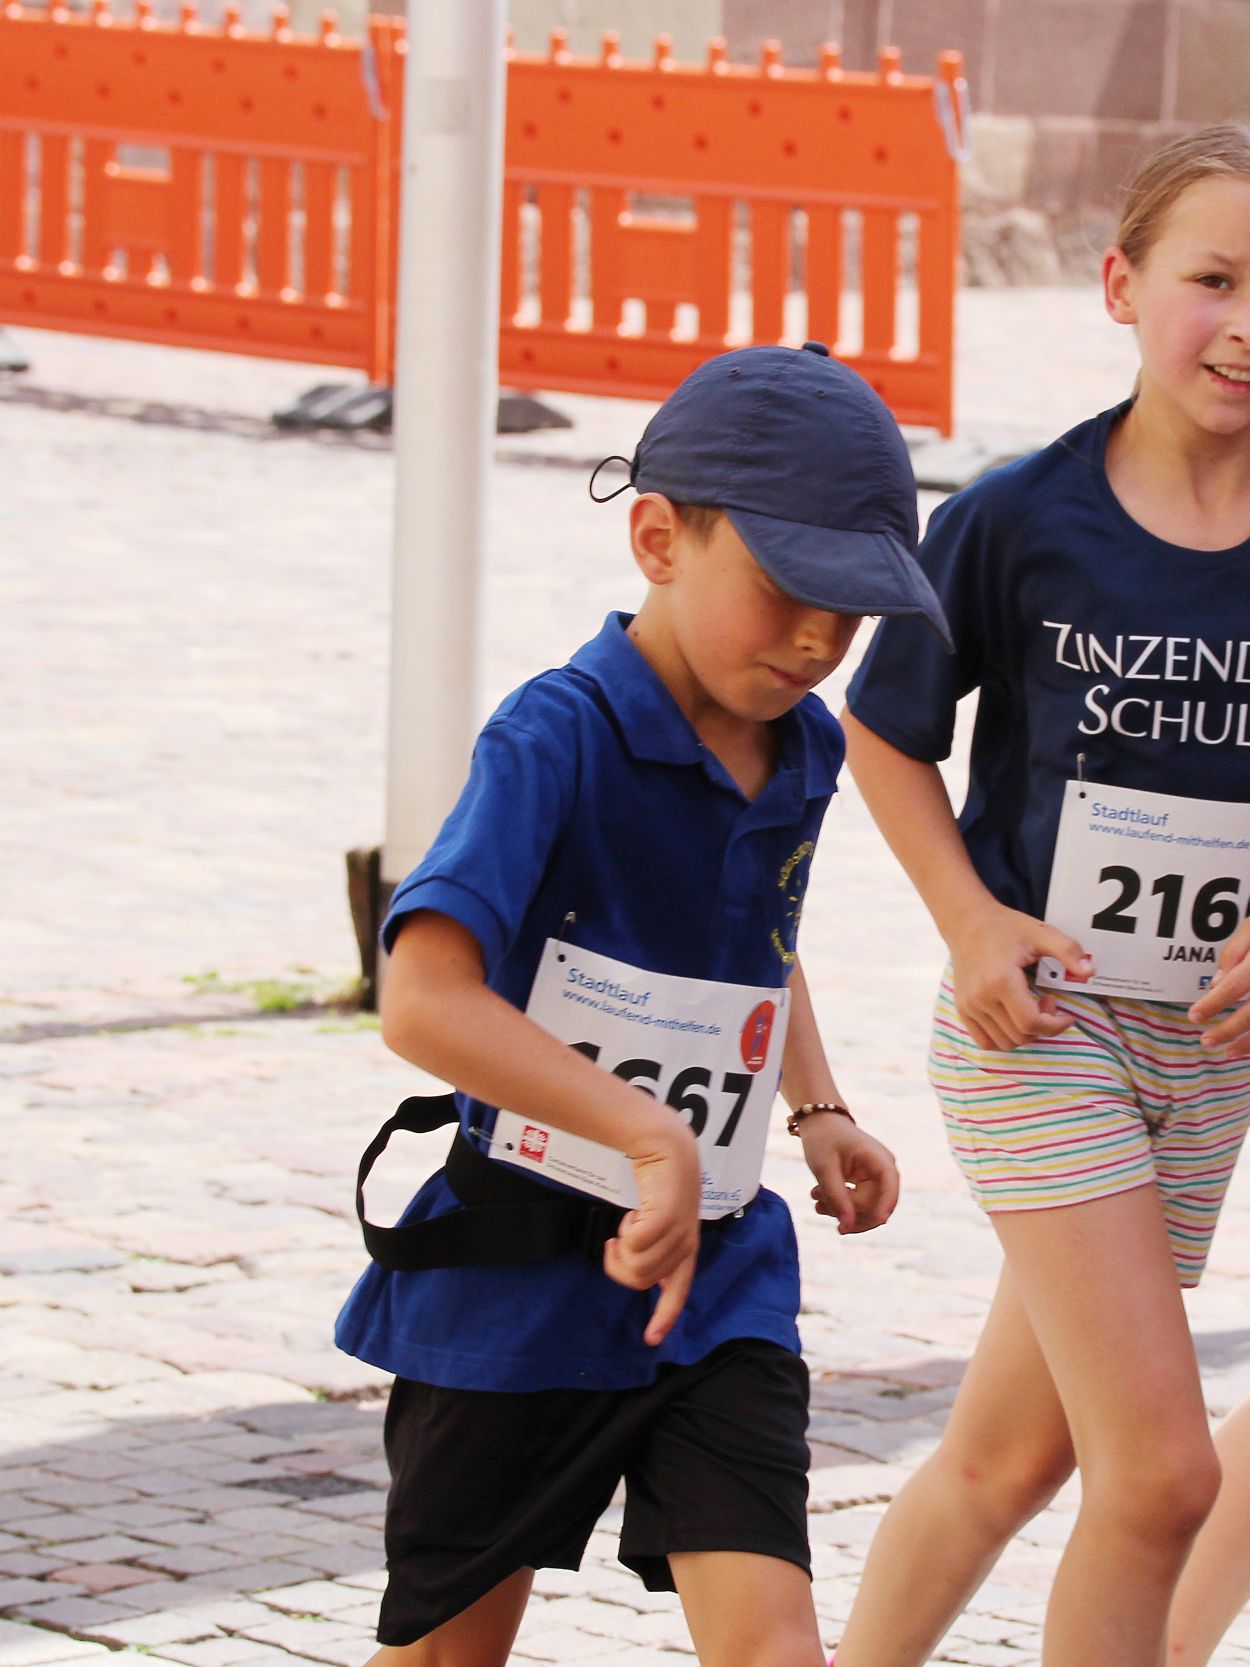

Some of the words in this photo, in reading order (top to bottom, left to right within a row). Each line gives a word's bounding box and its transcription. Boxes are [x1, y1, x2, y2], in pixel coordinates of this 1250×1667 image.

[1091, 802, 1170, 827] Stadtlauf
[1162, 944, 1216, 964] JANA
[566, 967, 653, 1007] Stadtlauf
